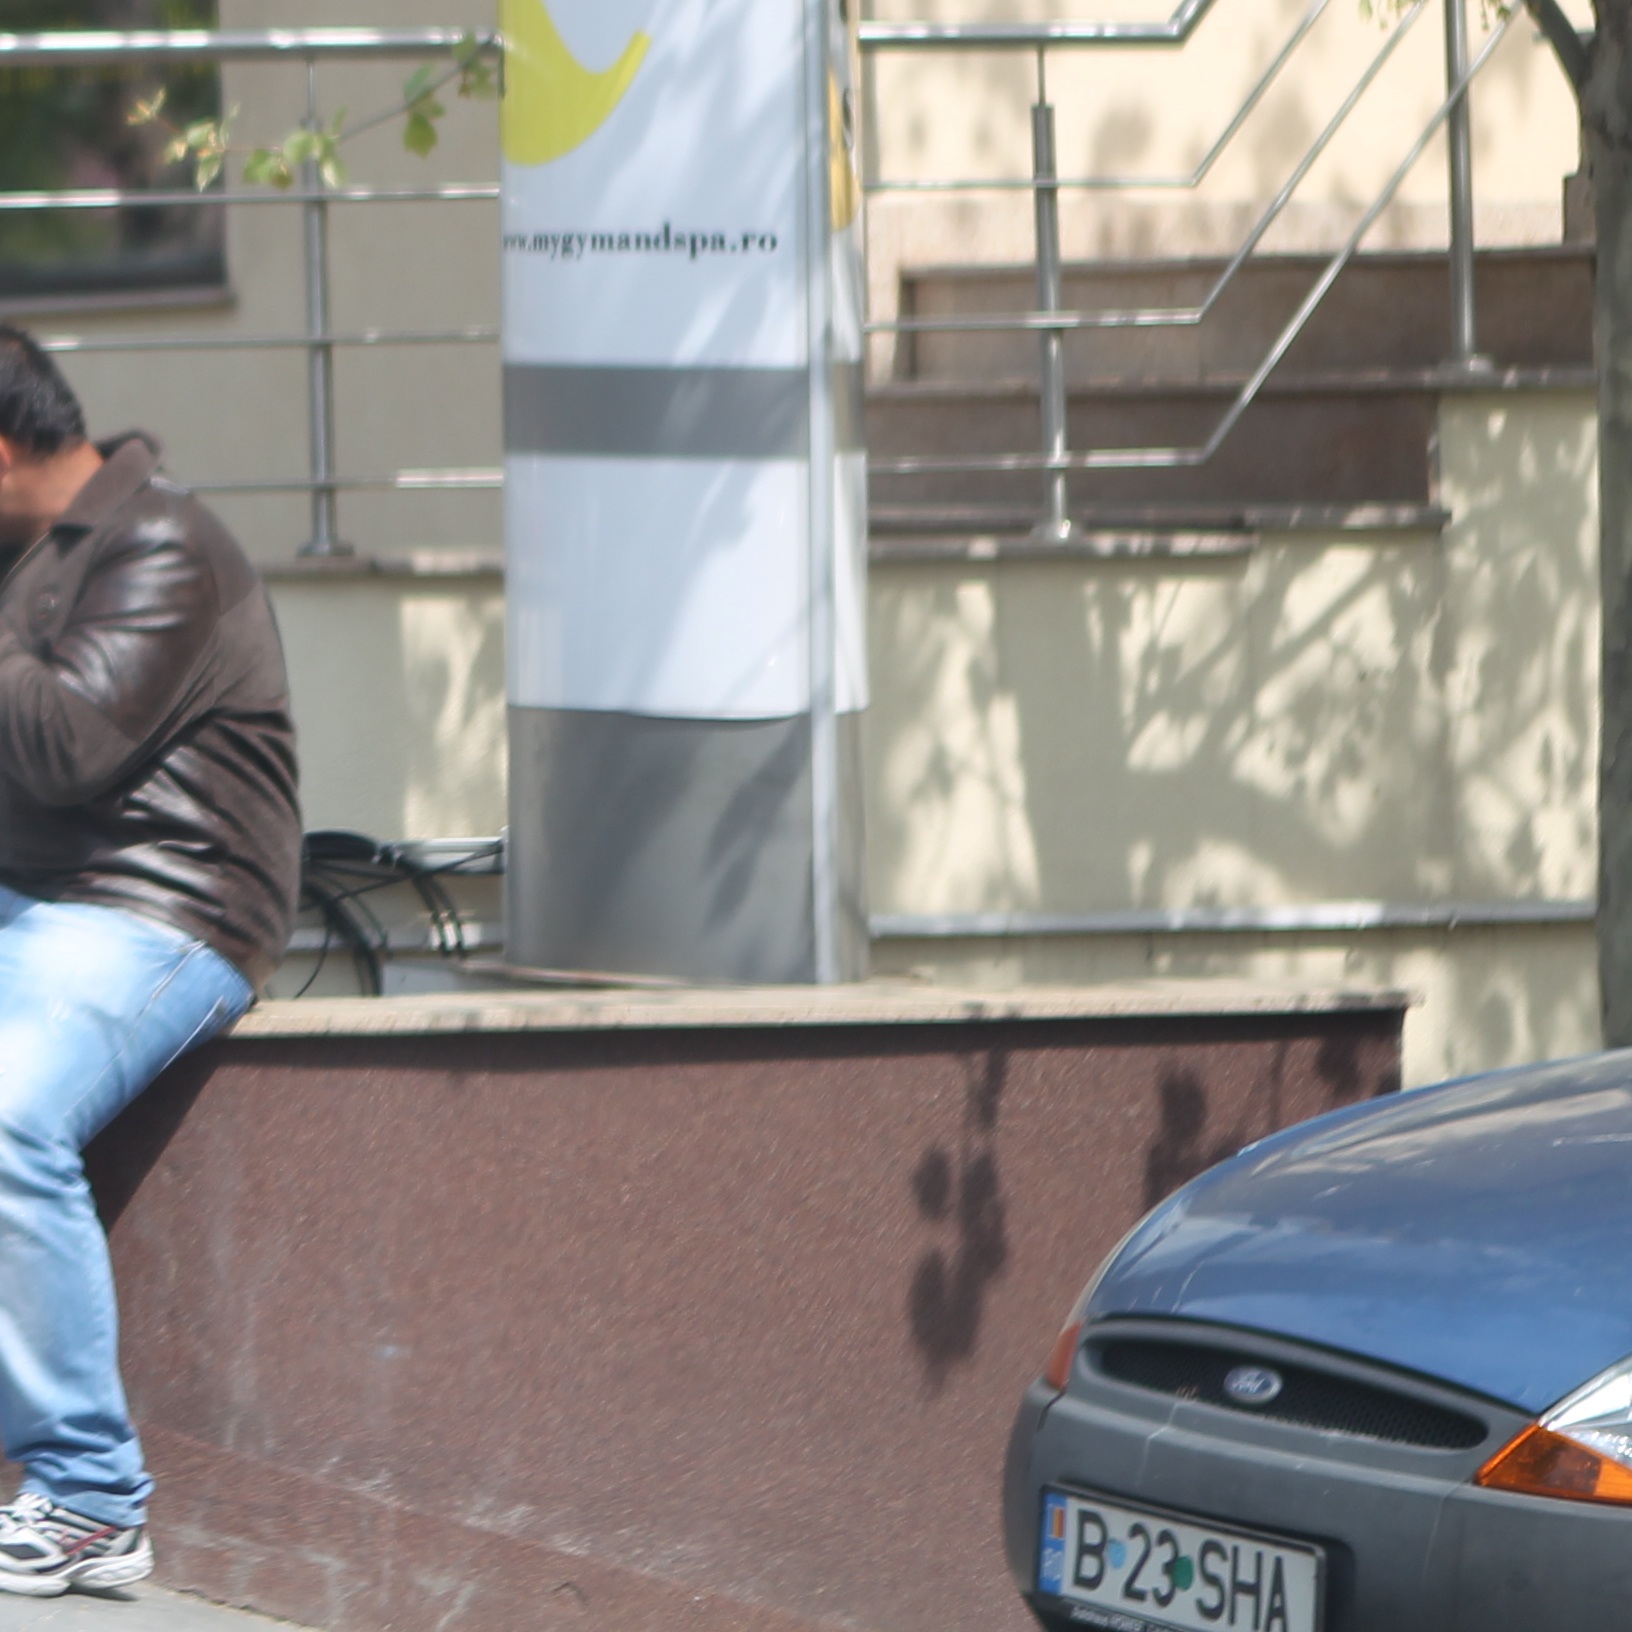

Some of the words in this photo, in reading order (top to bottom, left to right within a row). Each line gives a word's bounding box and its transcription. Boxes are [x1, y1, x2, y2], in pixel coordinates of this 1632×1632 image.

[1074, 1508, 1108, 1590] B
[1123, 1522, 1180, 1607] 23
[1196, 1539, 1287, 1632] SHA
